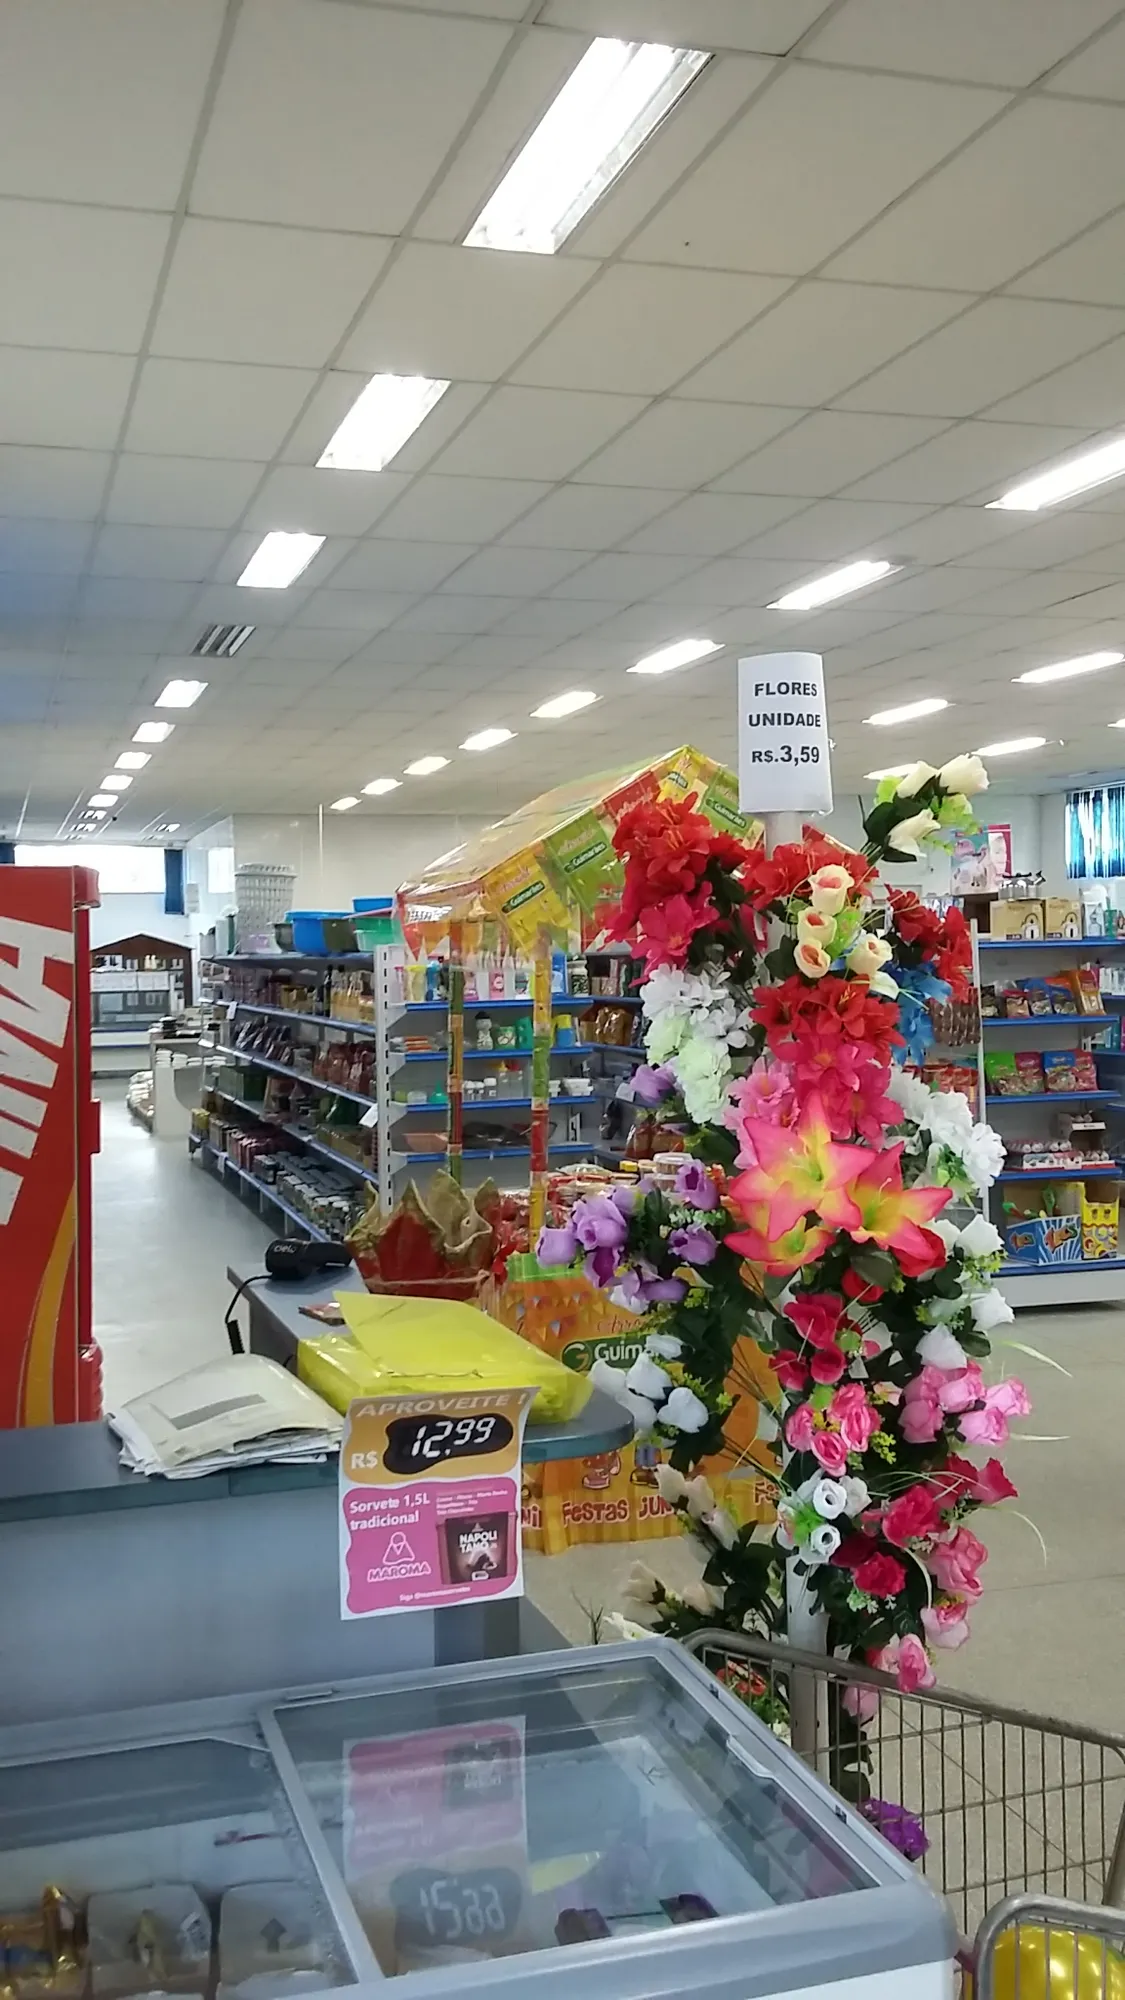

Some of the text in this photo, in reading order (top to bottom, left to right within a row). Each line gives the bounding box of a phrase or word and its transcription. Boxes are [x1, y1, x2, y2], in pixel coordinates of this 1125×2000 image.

[754, 681, 818, 697] FLORES
[748, 712, 821, 728] UNIDADE
[594, 1339, 646, 1362] Guim
[355, 1393, 508, 1418] APROVEITE
[411, 1416, 497, 1459] 12.99
[350, 1451, 379, 1470] R$
[349, 1497, 400, 1515] Sorvete
[403, 1492, 431, 1508] 1,5L
[349, 1510, 420, 1531] tradicional
[459, 1530, 498, 1544] NAPOLI
[367, 1561, 432, 1583] MAROMA
